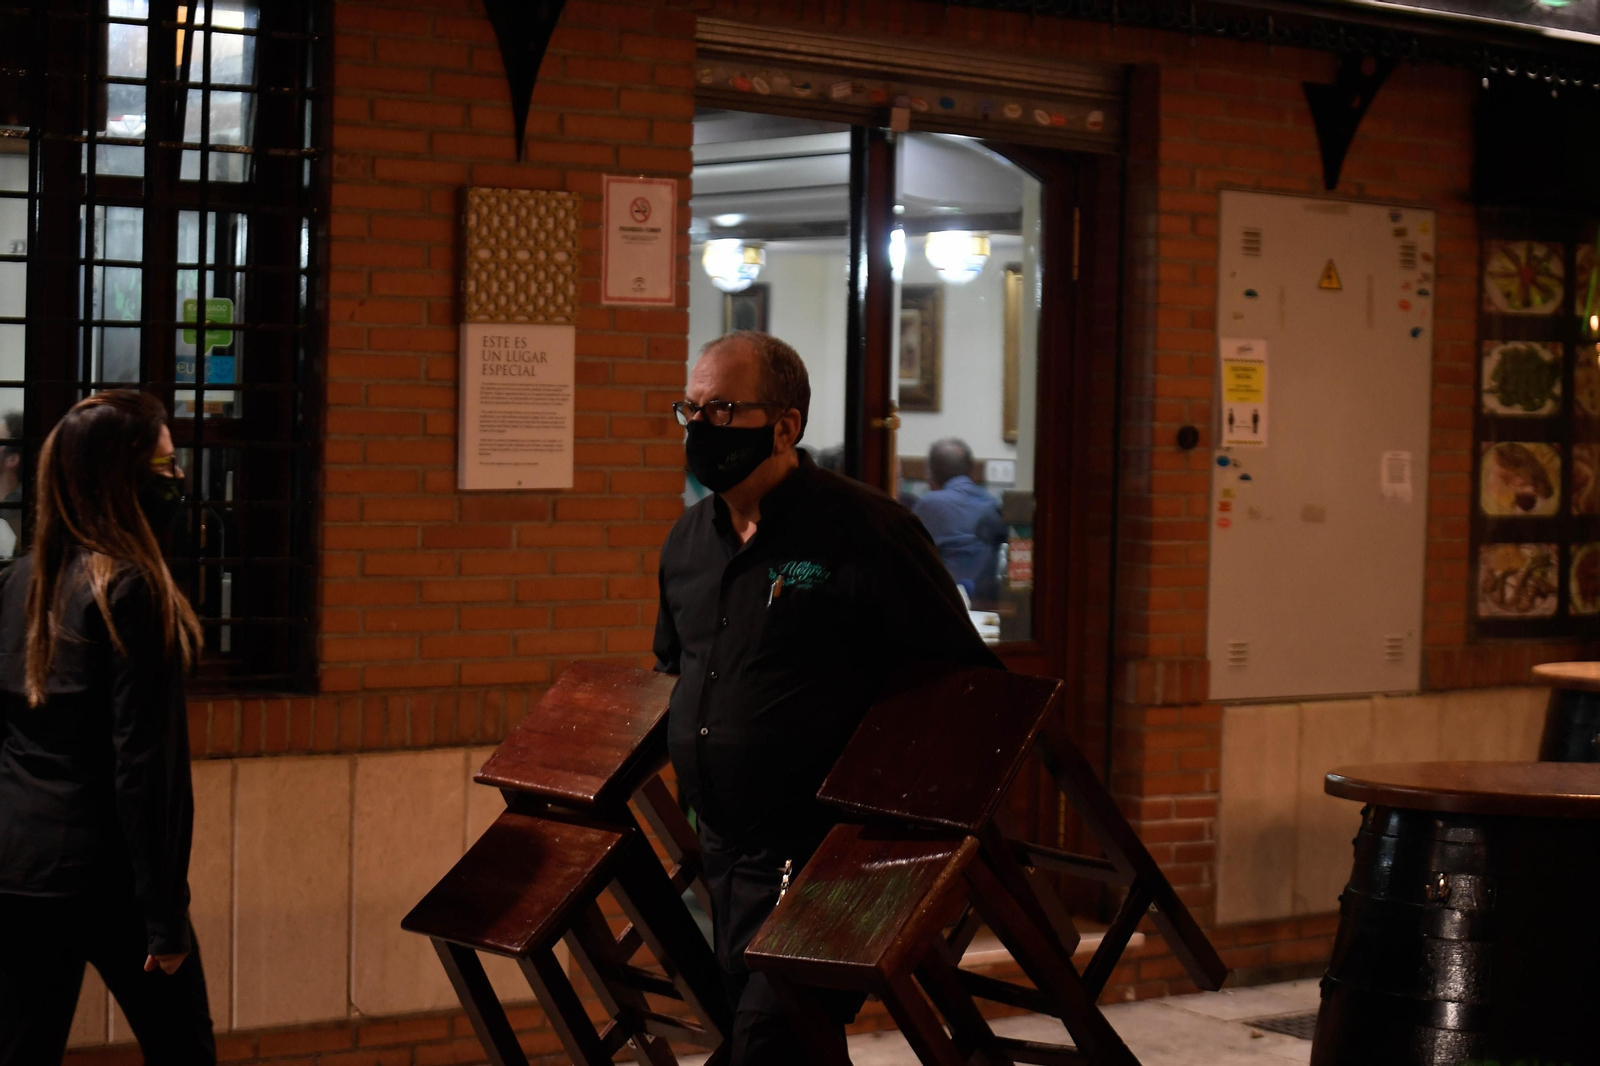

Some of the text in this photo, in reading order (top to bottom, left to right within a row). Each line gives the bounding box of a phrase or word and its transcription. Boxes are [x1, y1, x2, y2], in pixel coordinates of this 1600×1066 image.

[187, 303, 228, 312] EVUADO
[482, 336, 527, 348] ESTE ES
[481, 349, 548, 363] UN LUGAR
[481, 363, 537, 376] ESPECIAL
